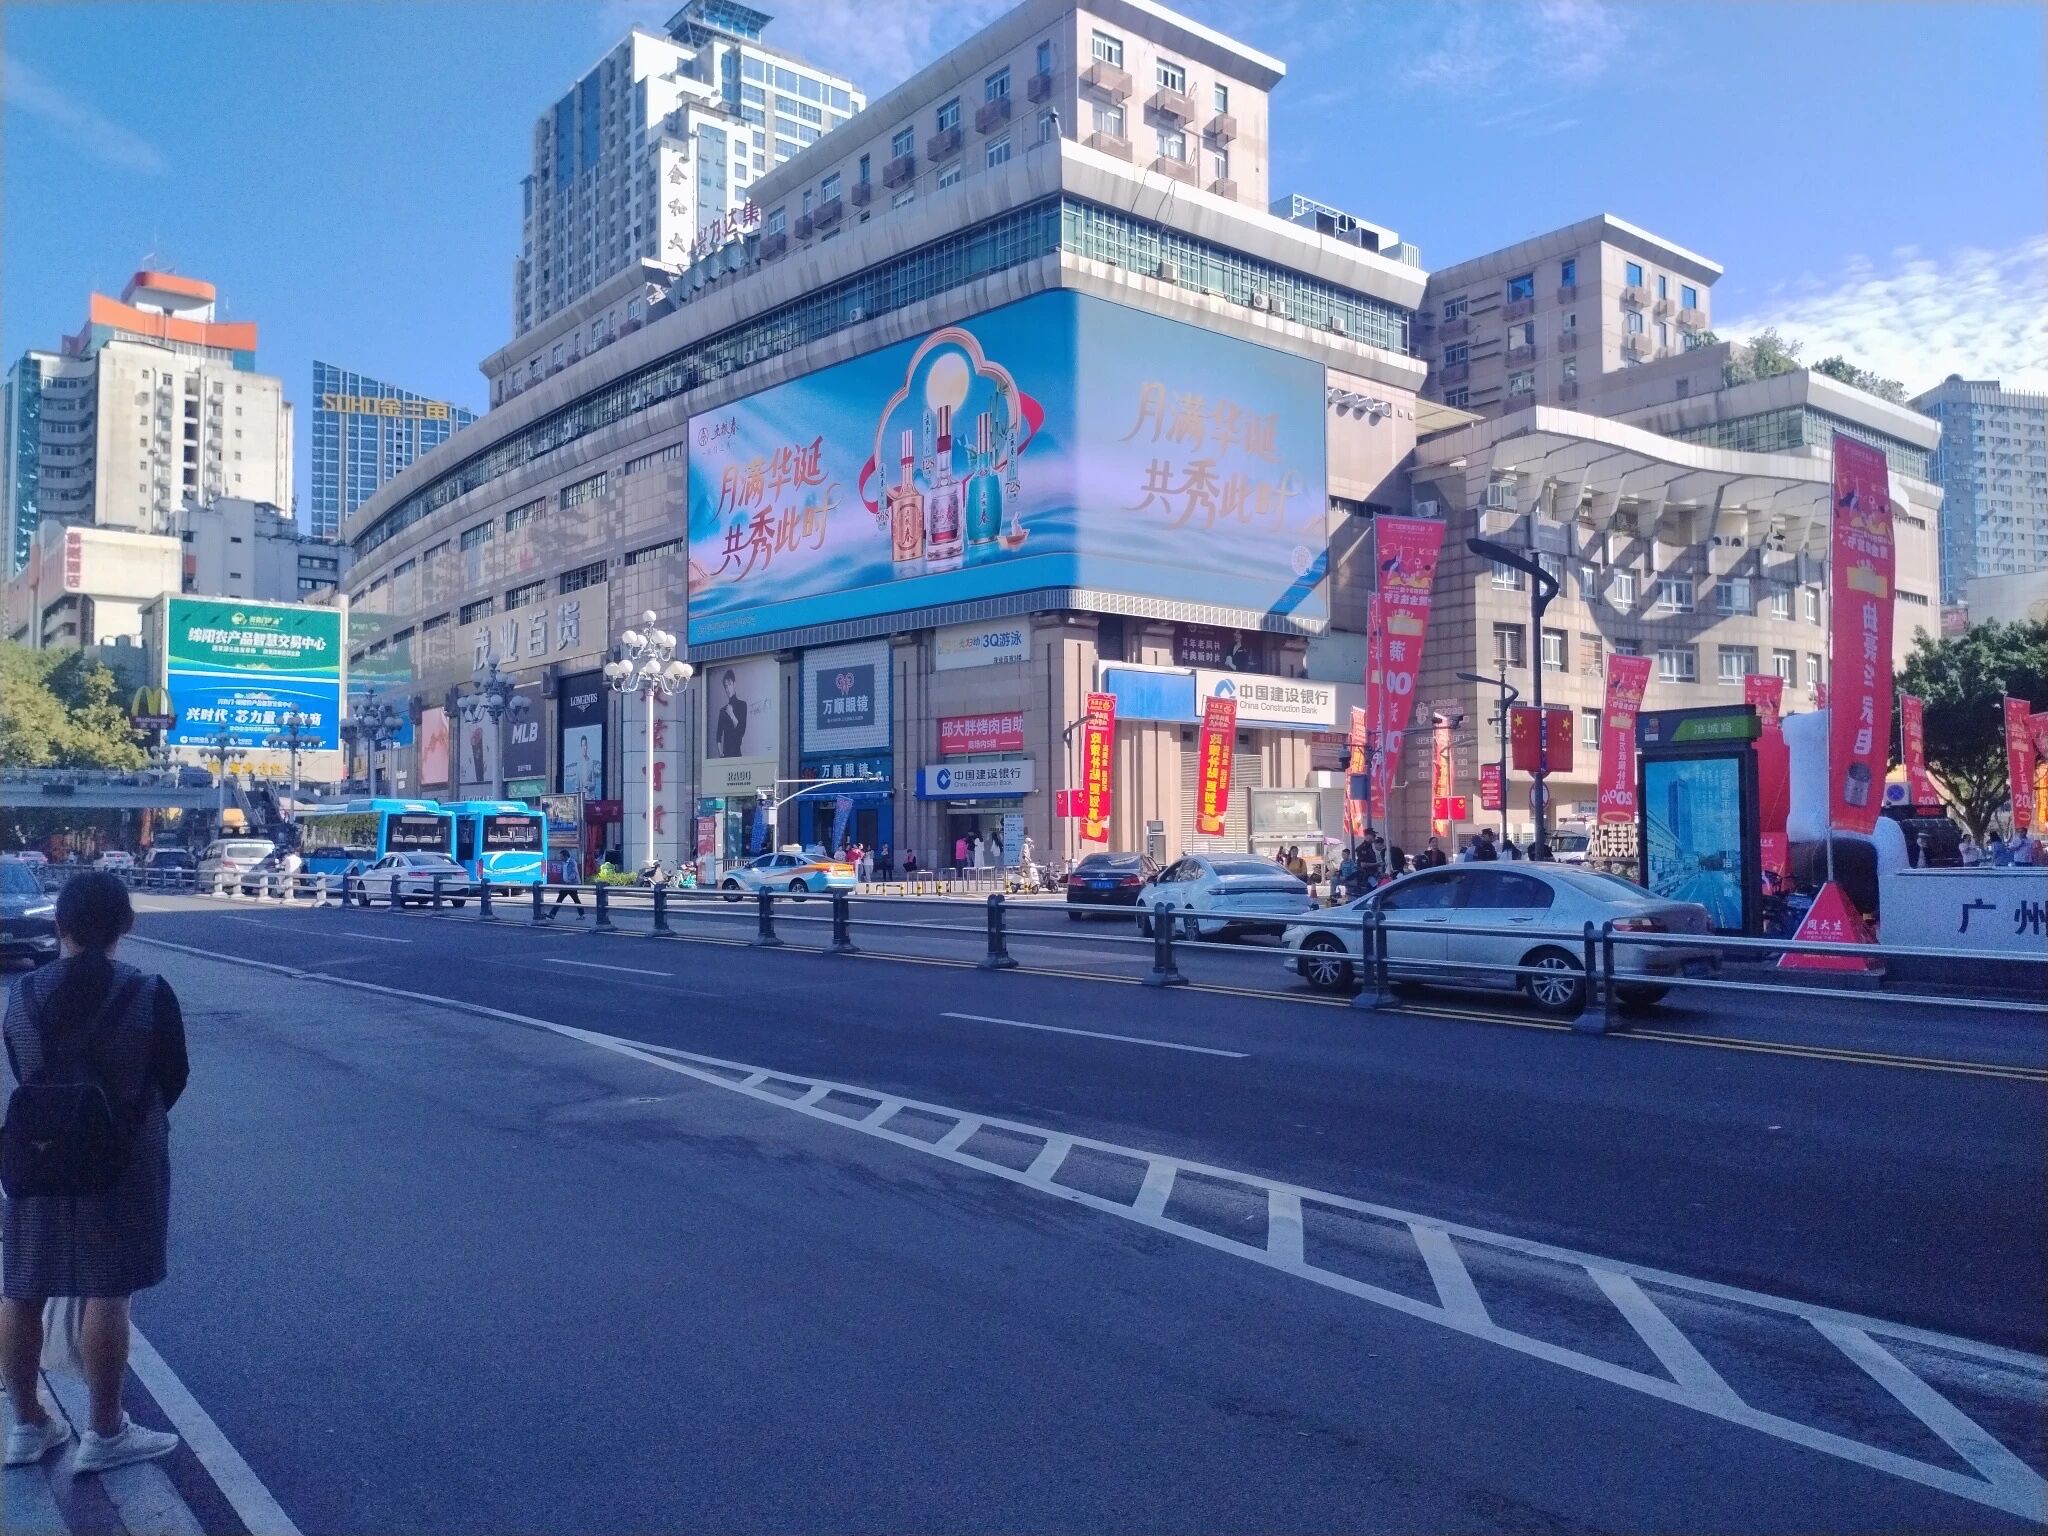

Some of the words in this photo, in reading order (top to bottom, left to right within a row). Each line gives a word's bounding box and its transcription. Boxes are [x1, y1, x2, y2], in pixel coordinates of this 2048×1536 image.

[1117, 381, 1281, 464] 月满华诞
[711, 435, 830, 523] 月满华诞
[1122, 458, 1301, 531] 共秀此时
[709, 483, 842, 582] 共秀此时
[187, 627, 327, 651] 绵阳农产品智慧交易中心
[472, 601, 580, 671] 茂业百货
[983, 630, 1022, 648] 3Q游泳
[570, 693, 598, 707] LONGINES
[822, 694, 869, 715] 万顺眼镜
[1239, 684, 1329, 706] 中国建设银行
[1239, 700, 1259, 709] China
[1260, 702, 1300, 713] Construction
[1301, 705, 1318, 714] Bank
[511, 722, 538, 745] MLB
[941, 716, 1024, 738] 邱大胖烤肉自助
[821, 762, 869, 778] 万顺眼镜
[954, 767, 1021, 781] 中国建设银行
[1806, 919, 1842, 931] 周大生
[1958, 898, 2048, 937] 广州
